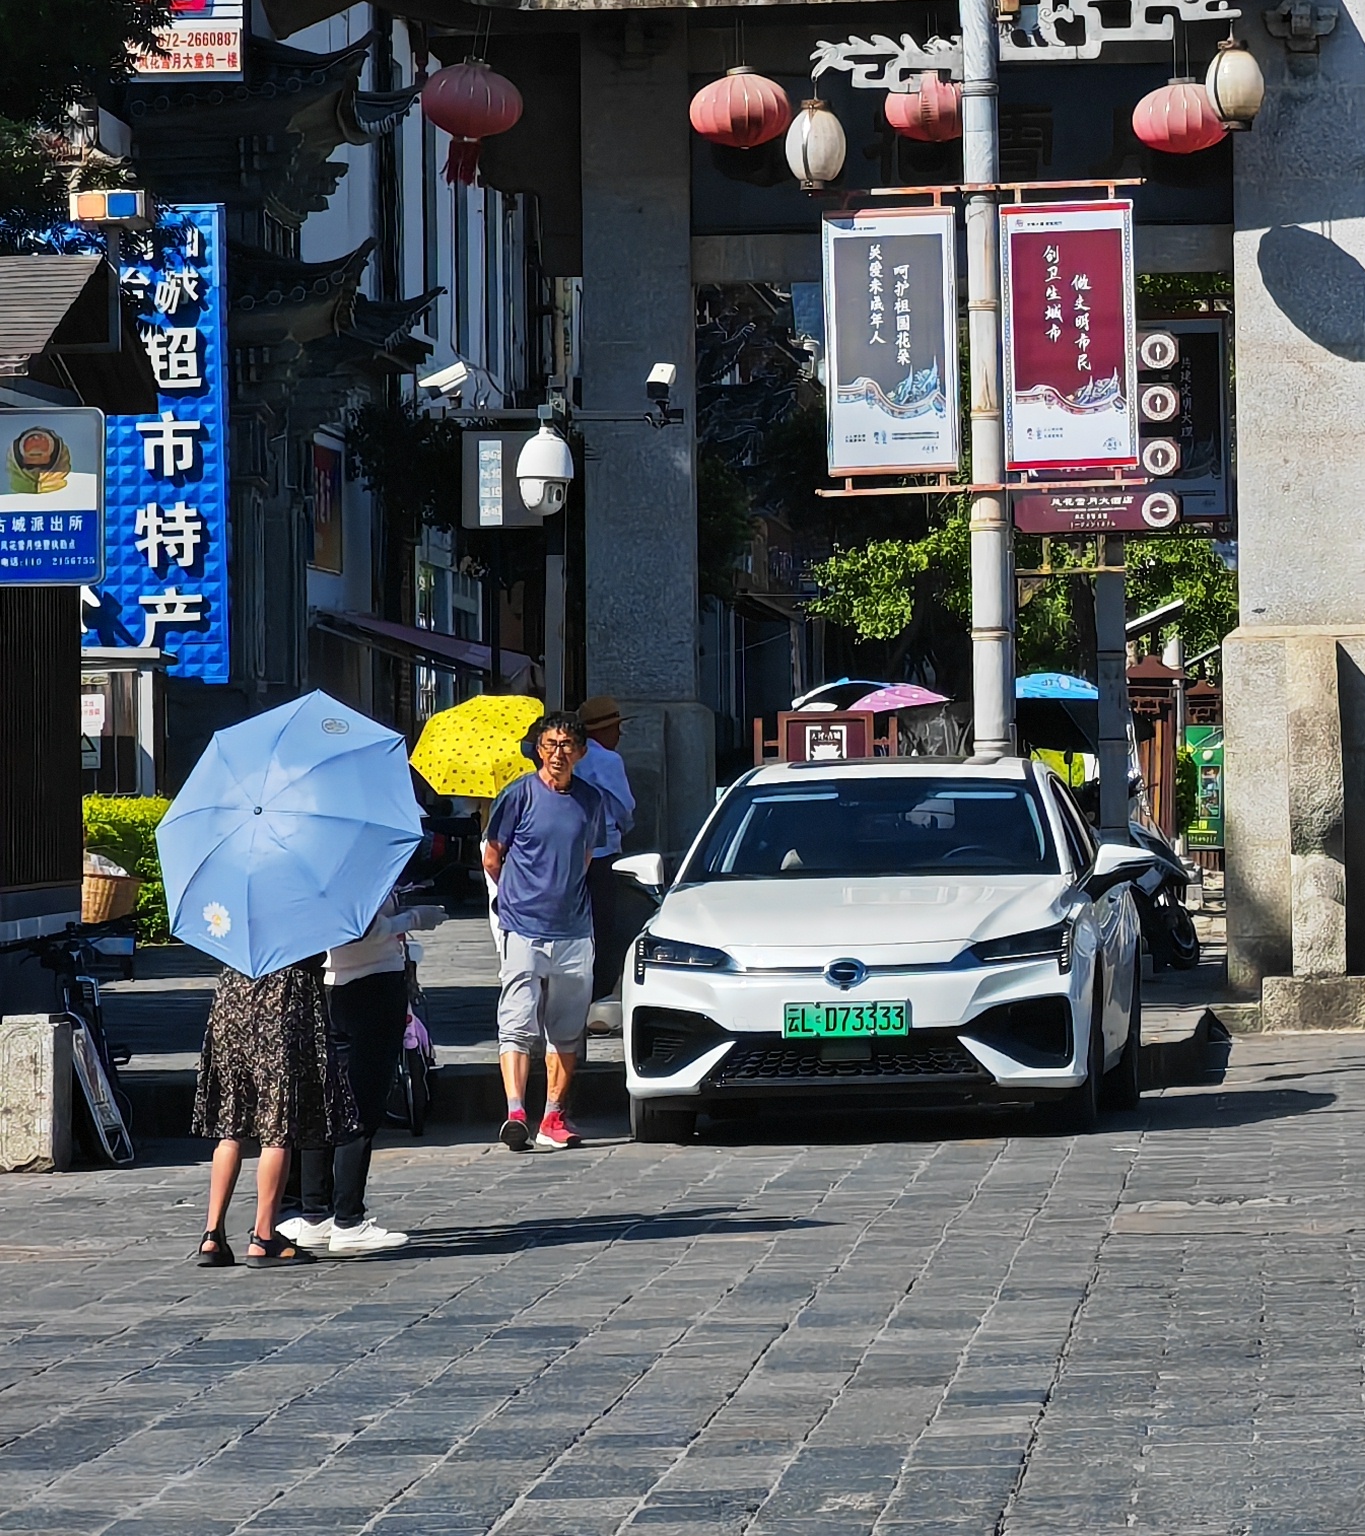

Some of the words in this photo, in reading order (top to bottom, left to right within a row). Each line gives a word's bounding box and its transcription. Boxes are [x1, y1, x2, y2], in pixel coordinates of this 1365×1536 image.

[868, 244, 887, 345] 关爱未成年人
[893, 264, 912, 366] 呵护祖国花朵
[1043, 245, 1064, 343] 创卫生城市
[1071, 273, 1092, 372] 做文明市民
